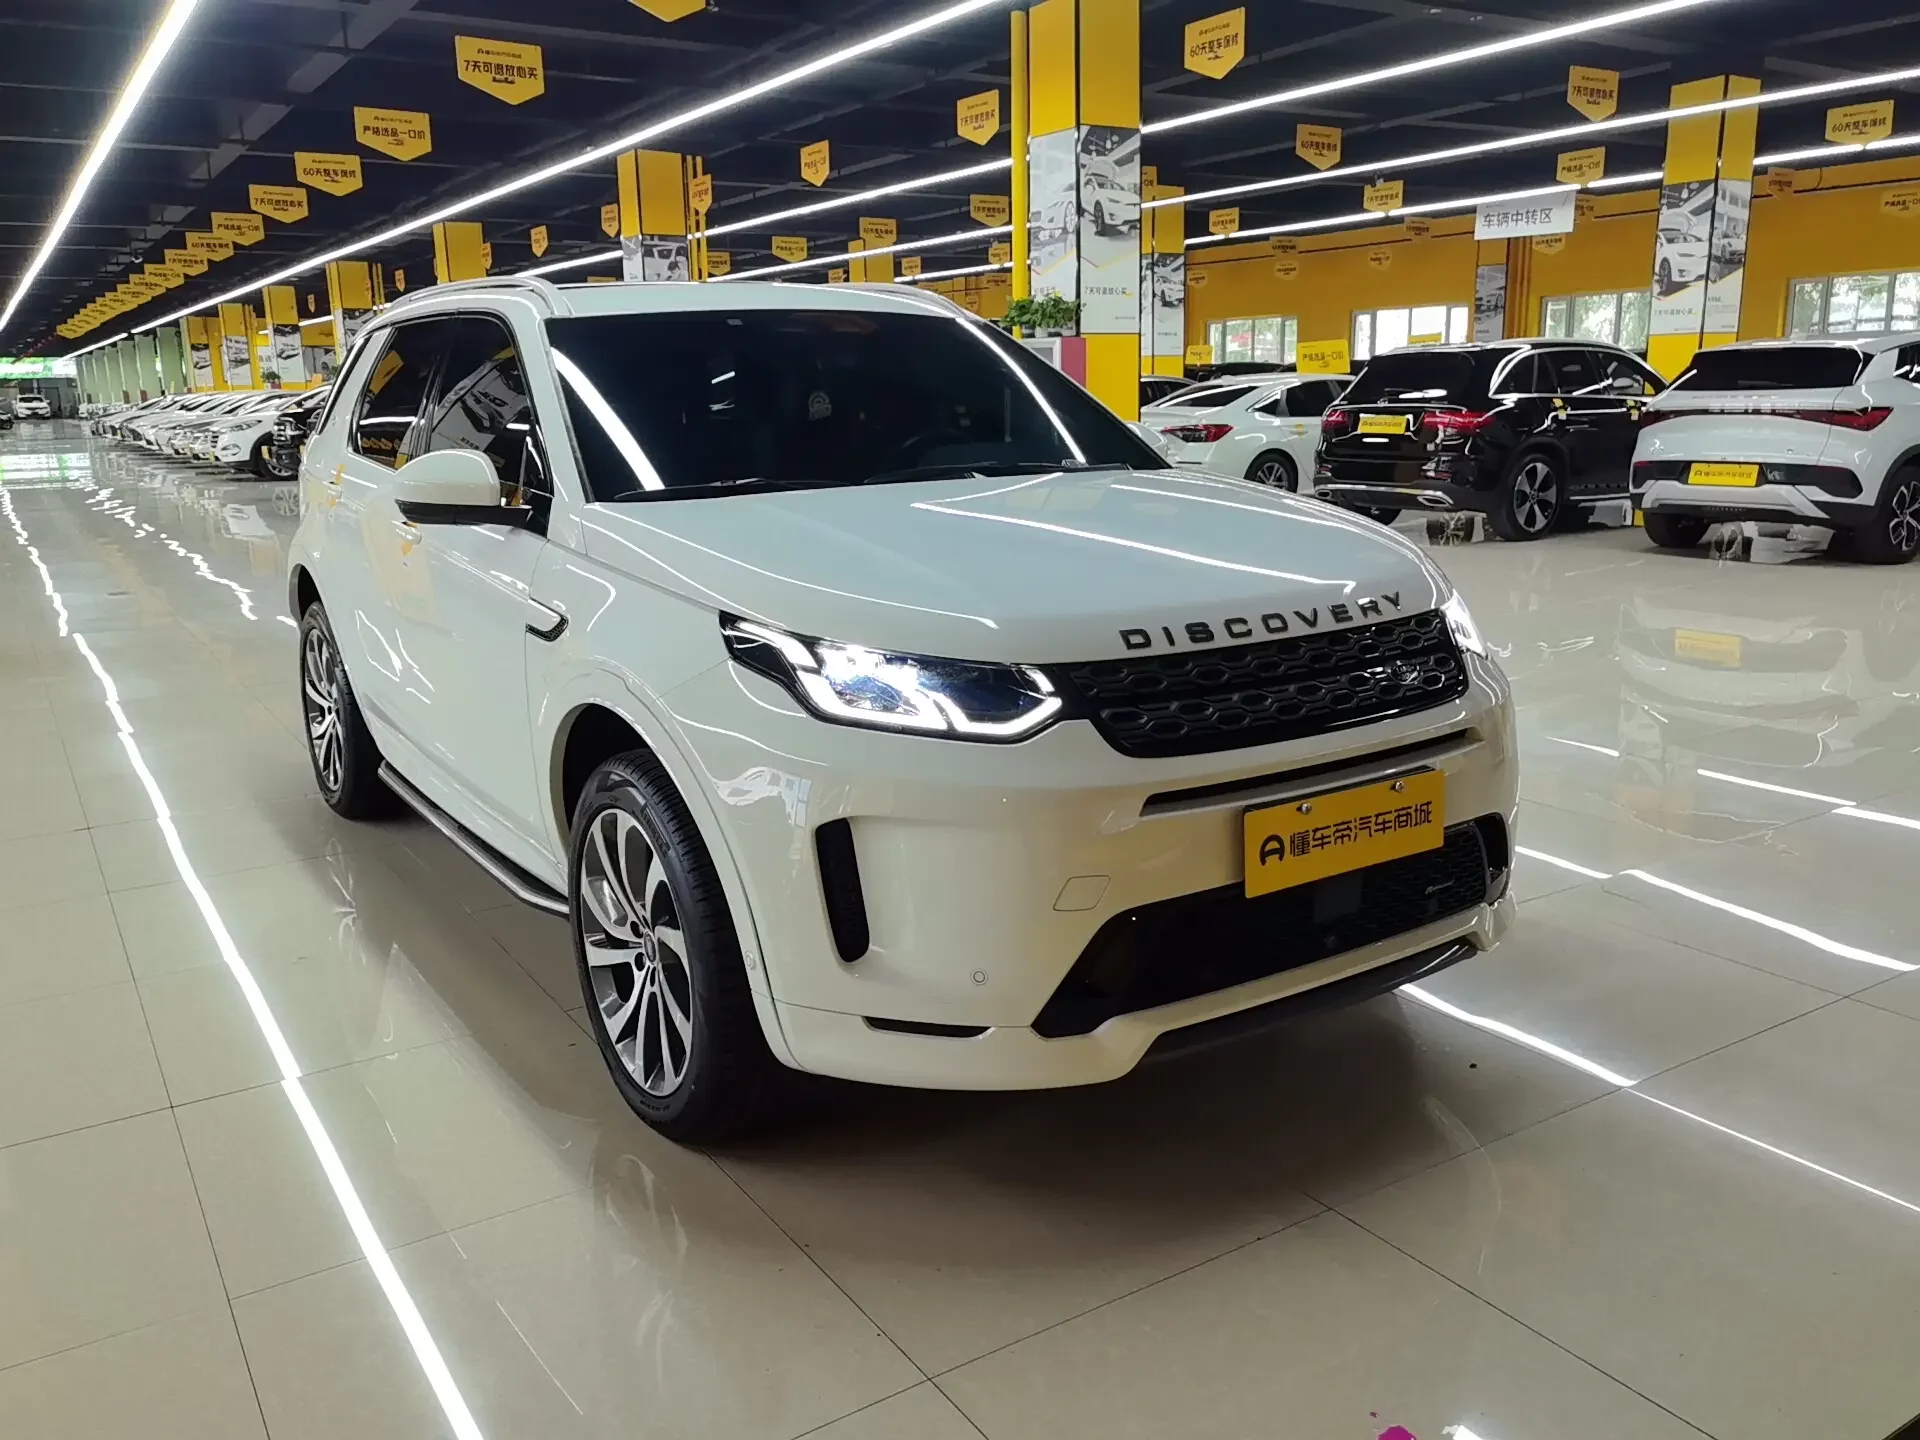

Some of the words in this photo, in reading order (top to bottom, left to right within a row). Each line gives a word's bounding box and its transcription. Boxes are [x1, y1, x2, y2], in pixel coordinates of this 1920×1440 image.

[1189, 32, 1239, 58] 60天整车保修
[463, 59, 539, 80] 7天可退放心买
[362, 125, 426, 141] 严格选品一口价
[1831, 116, 1888, 133] 60天整车保修
[302, 168, 357, 179] 60天整车保修
[1482, 207, 1553, 229] 车辆中转区
[1084, 286, 1128, 296] 7天可退放心买
[1119, 591, 1404, 650] DISCOVERY
[1289, 800, 1433, 858] 懂车帝汽车商城
